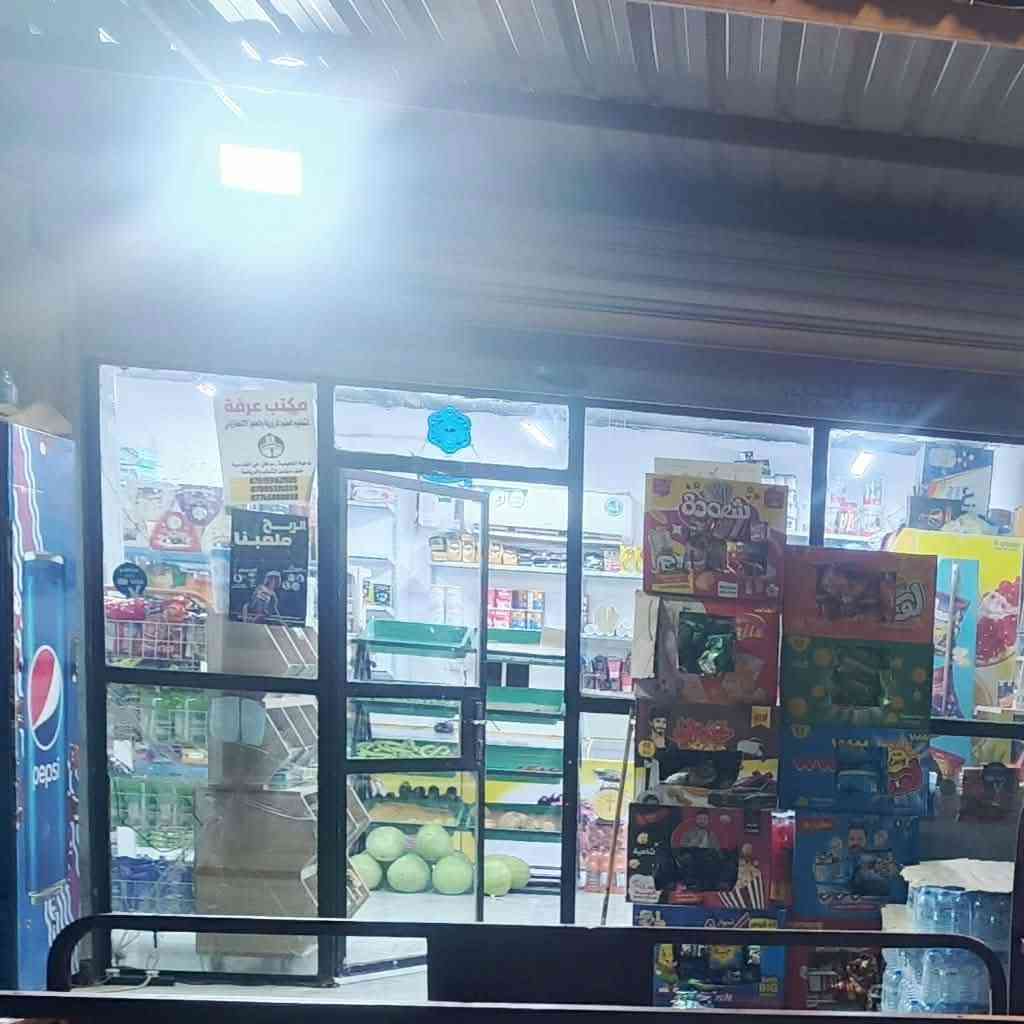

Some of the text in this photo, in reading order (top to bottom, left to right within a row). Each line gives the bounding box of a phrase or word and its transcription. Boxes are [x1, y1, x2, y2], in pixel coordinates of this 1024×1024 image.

[224, 396, 308, 416] مكتب عرفة
[234, 531, 292, 549] ملعبنا
[32, 756, 61, 791] pepsi
